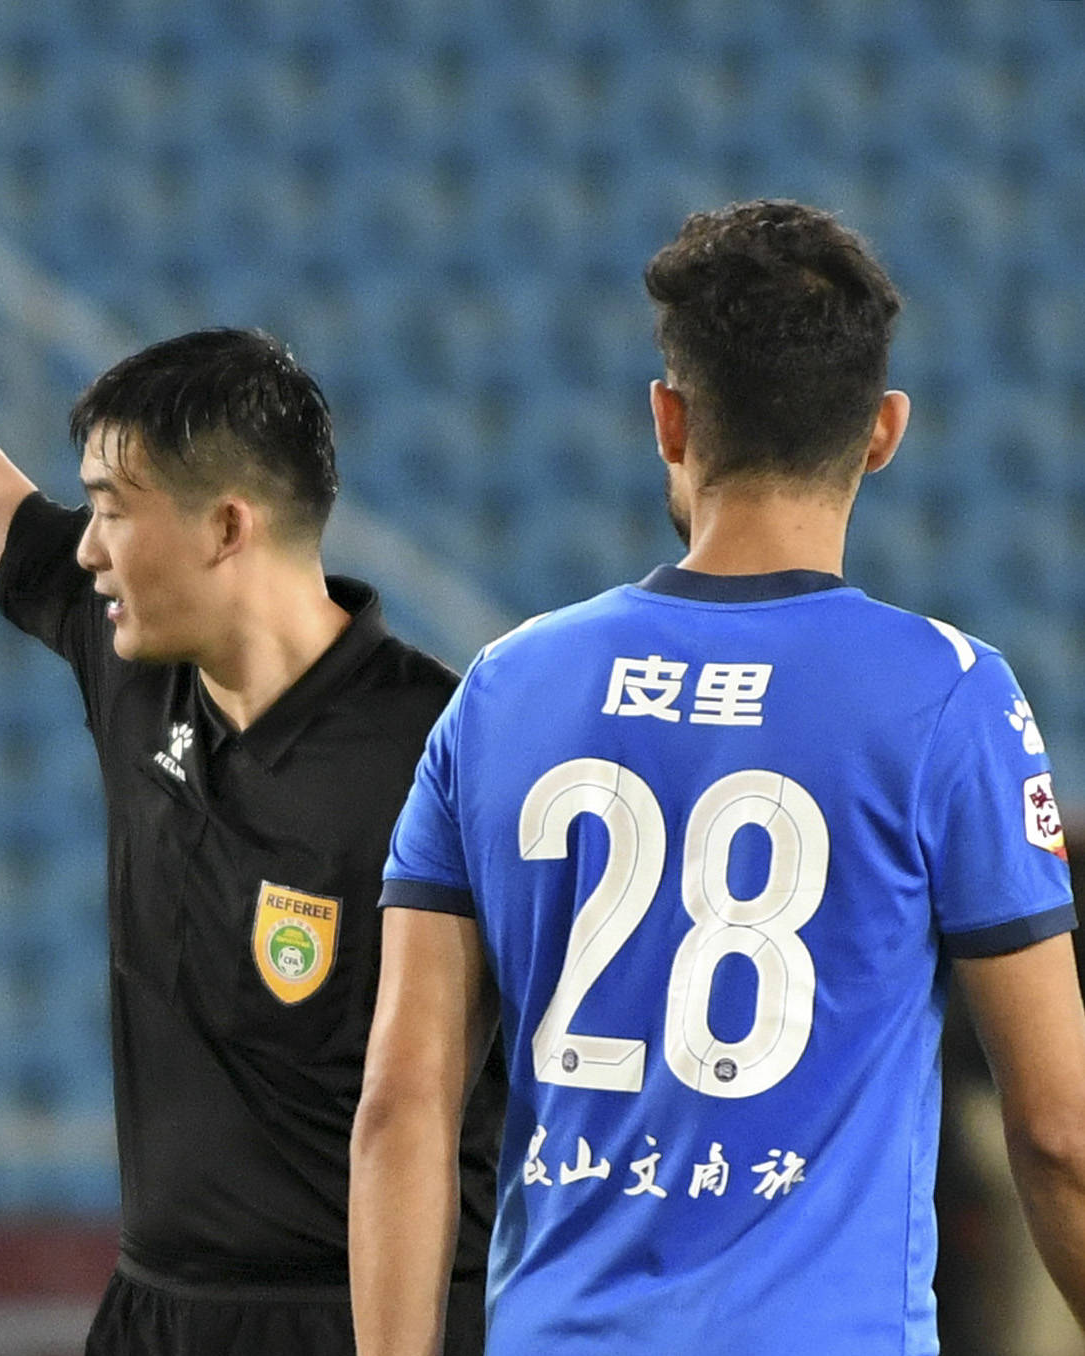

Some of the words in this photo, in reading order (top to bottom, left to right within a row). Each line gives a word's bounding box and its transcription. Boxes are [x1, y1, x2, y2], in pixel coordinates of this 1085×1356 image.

[602, 655, 773, 726] 皮里
[266, 894, 333, 920] REFEREE
[519, 757, 830, 1099] 28
